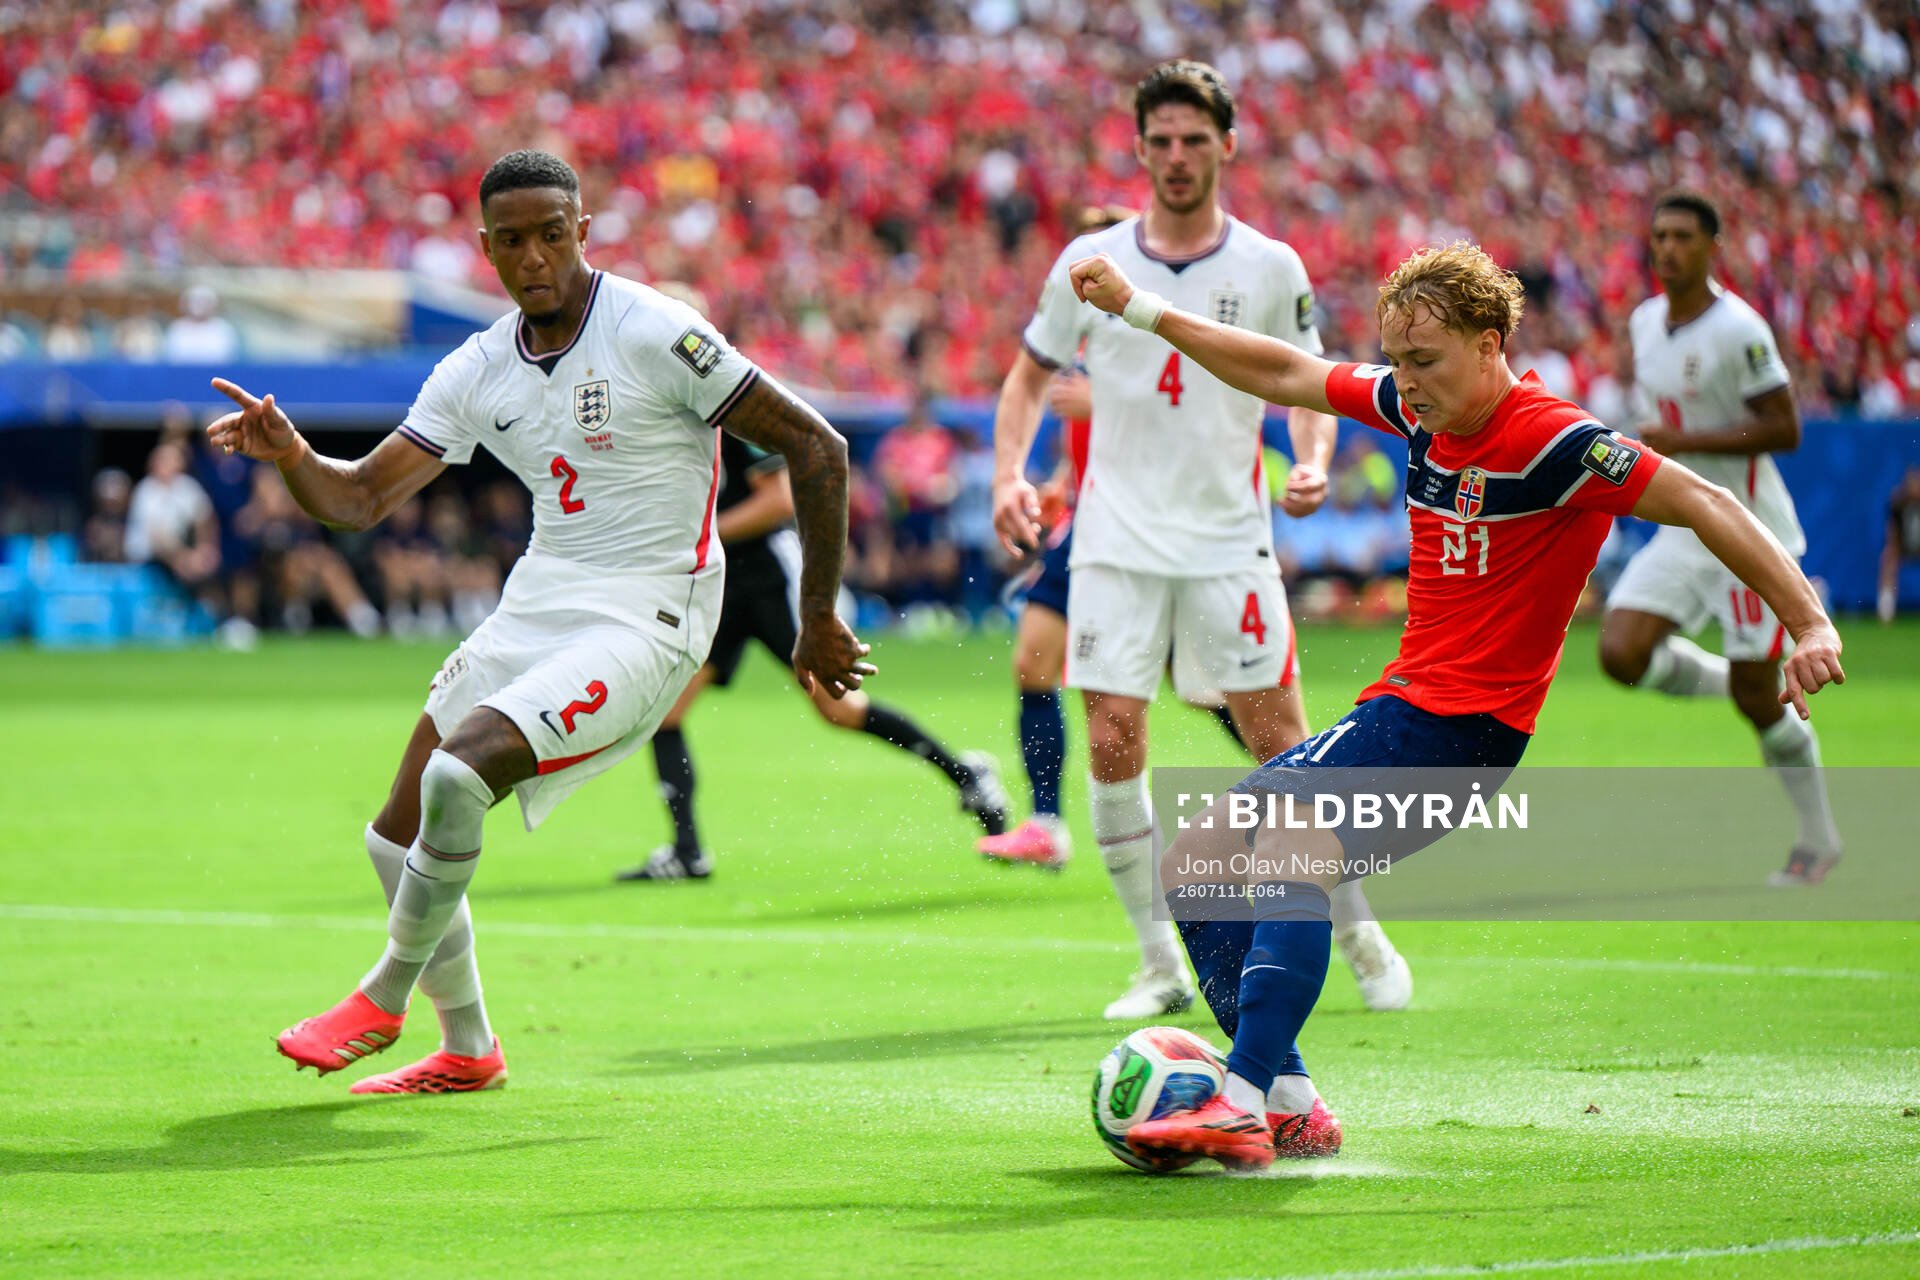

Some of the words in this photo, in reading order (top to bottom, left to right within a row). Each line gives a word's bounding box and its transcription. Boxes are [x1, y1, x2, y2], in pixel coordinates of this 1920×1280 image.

[1157, 350, 1184, 406] 4
[550, 455, 585, 515] 2
[1439, 521, 1490, 576] 21
[1241, 592, 1267, 645] 4
[1729, 587, 1762, 628] 10
[559, 680, 608, 735] 2
